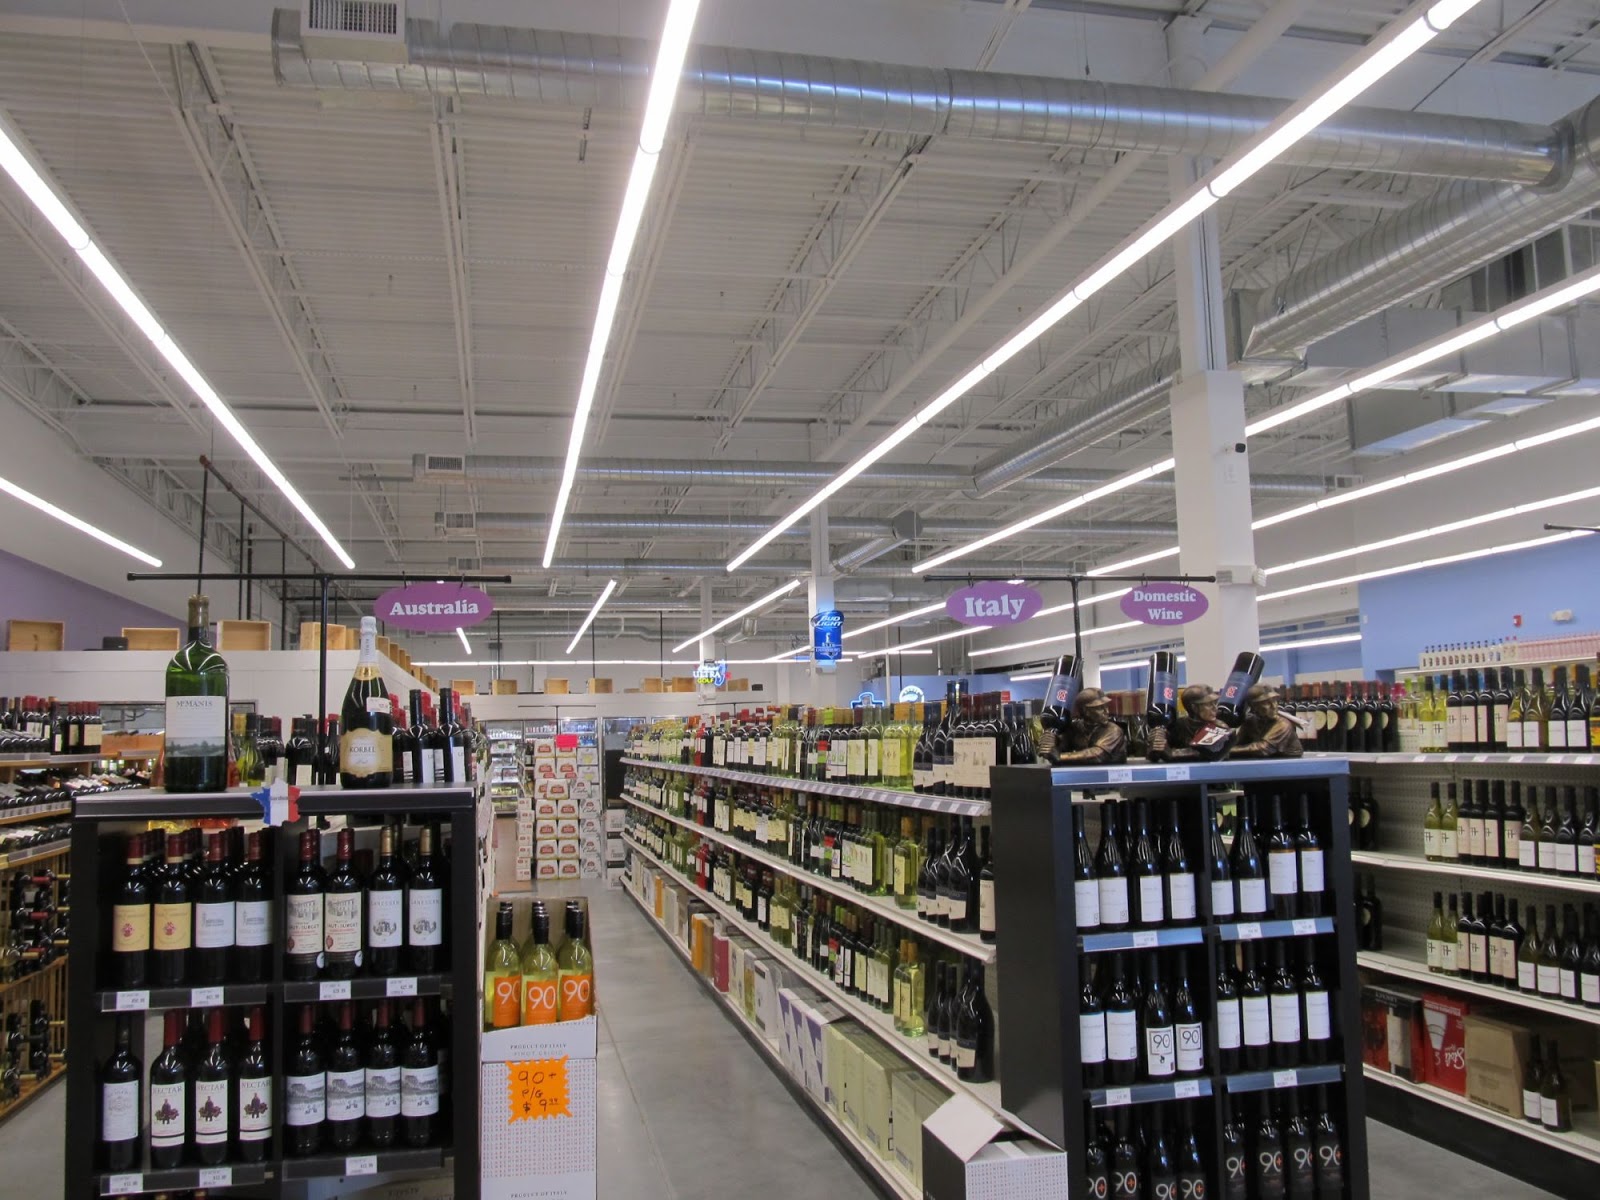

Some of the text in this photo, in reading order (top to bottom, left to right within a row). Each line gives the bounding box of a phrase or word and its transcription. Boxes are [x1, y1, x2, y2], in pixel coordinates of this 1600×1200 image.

[1133, 590, 1197, 602] Domestic
[389, 599, 480, 616] Australia
[964, 594, 1025, 620] Italy
[1148, 607, 1183, 620] Wine
[693, 670, 721, 679] ULTRA
[528, 985, 556, 1010] 90
[1153, 1033, 1170, 1048] 90
[1182, 1029, 1199, 1044] 90
[153, 1085, 183, 1095] NECTAR
[198, 1083, 225, 1092] NECTAR
[241, 1080, 272, 1089] NECTAR
